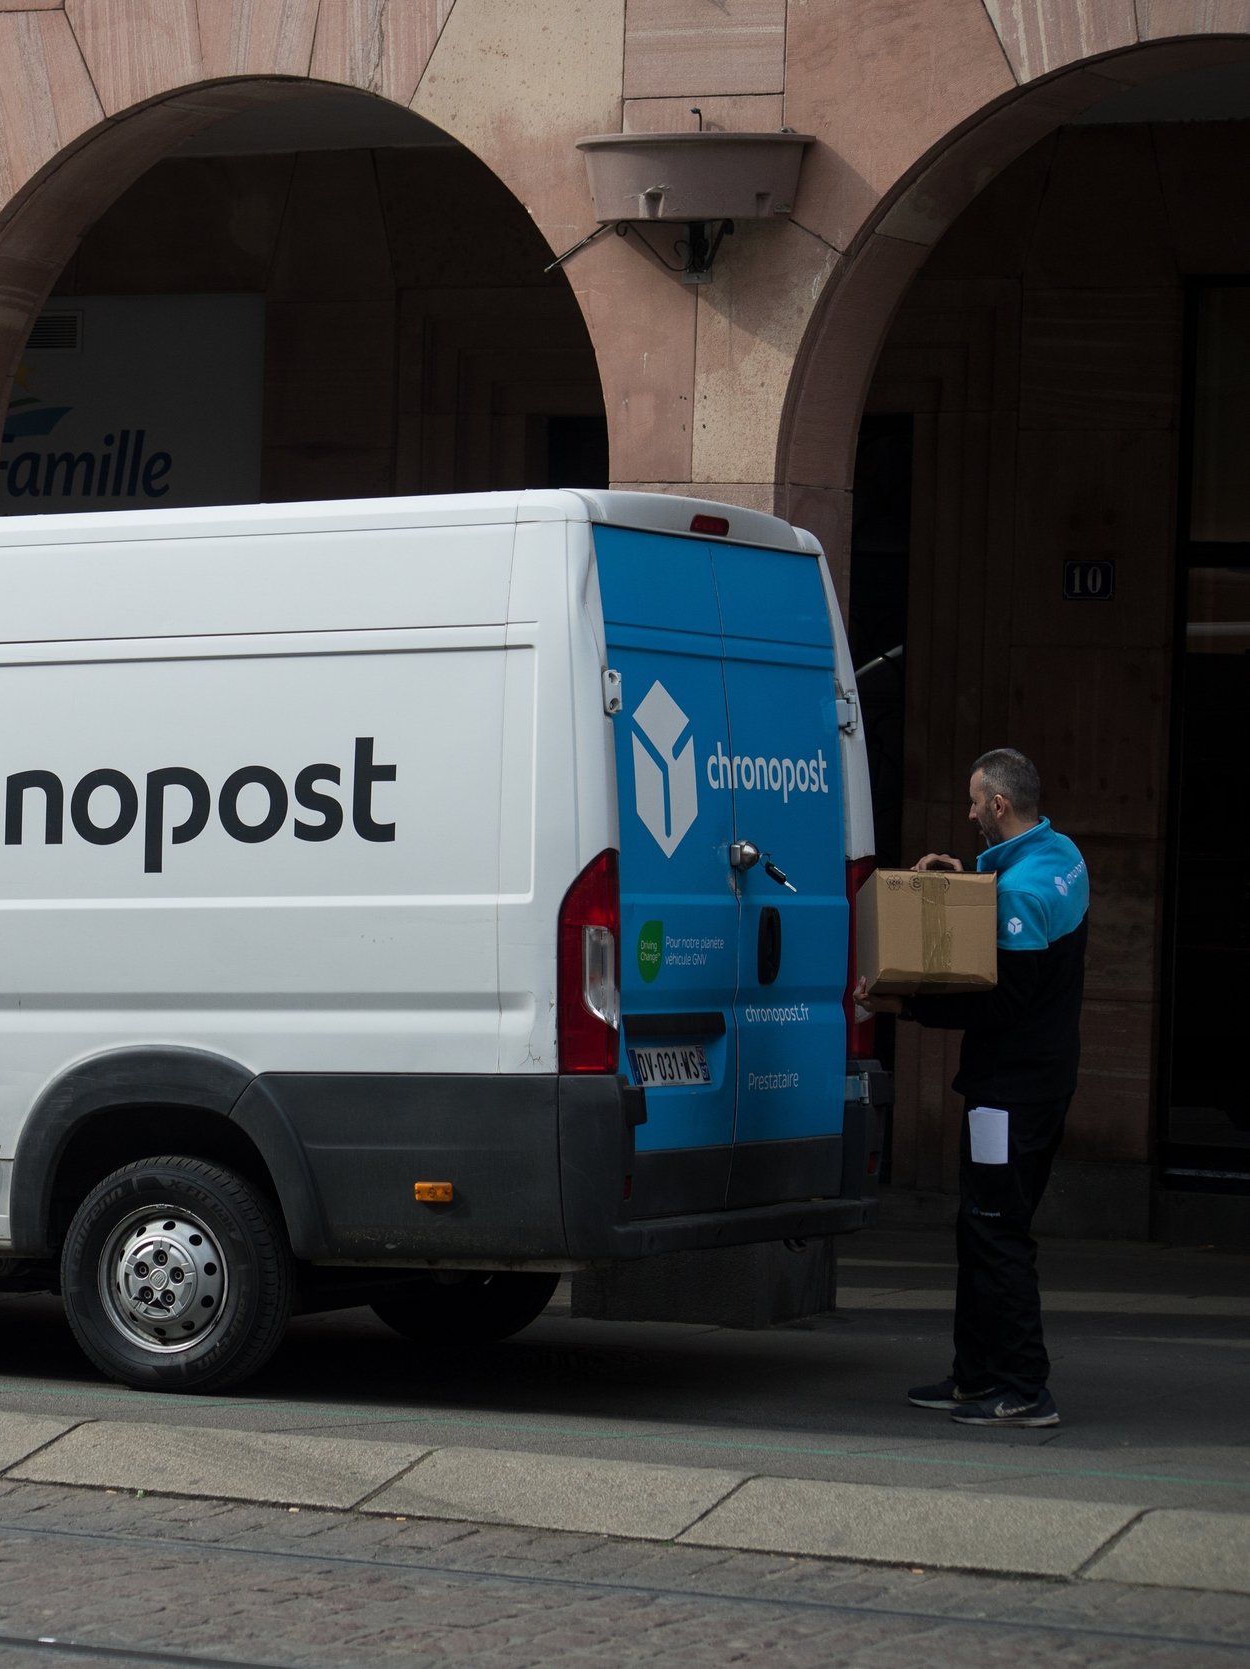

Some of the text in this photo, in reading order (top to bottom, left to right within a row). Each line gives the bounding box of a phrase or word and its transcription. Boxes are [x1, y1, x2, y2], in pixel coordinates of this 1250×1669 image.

[1072, 565, 1103, 594] 10
[706, 741, 829, 804] chronopost
[640, 940, 658, 953] Driving
[665, 935, 725, 952] Pour notre planète
[664, 952, 707, 966] véhicule GNV
[745, 1003, 810, 1027] chronopost.fr
[748, 1068, 799, 1096] Prestataire
